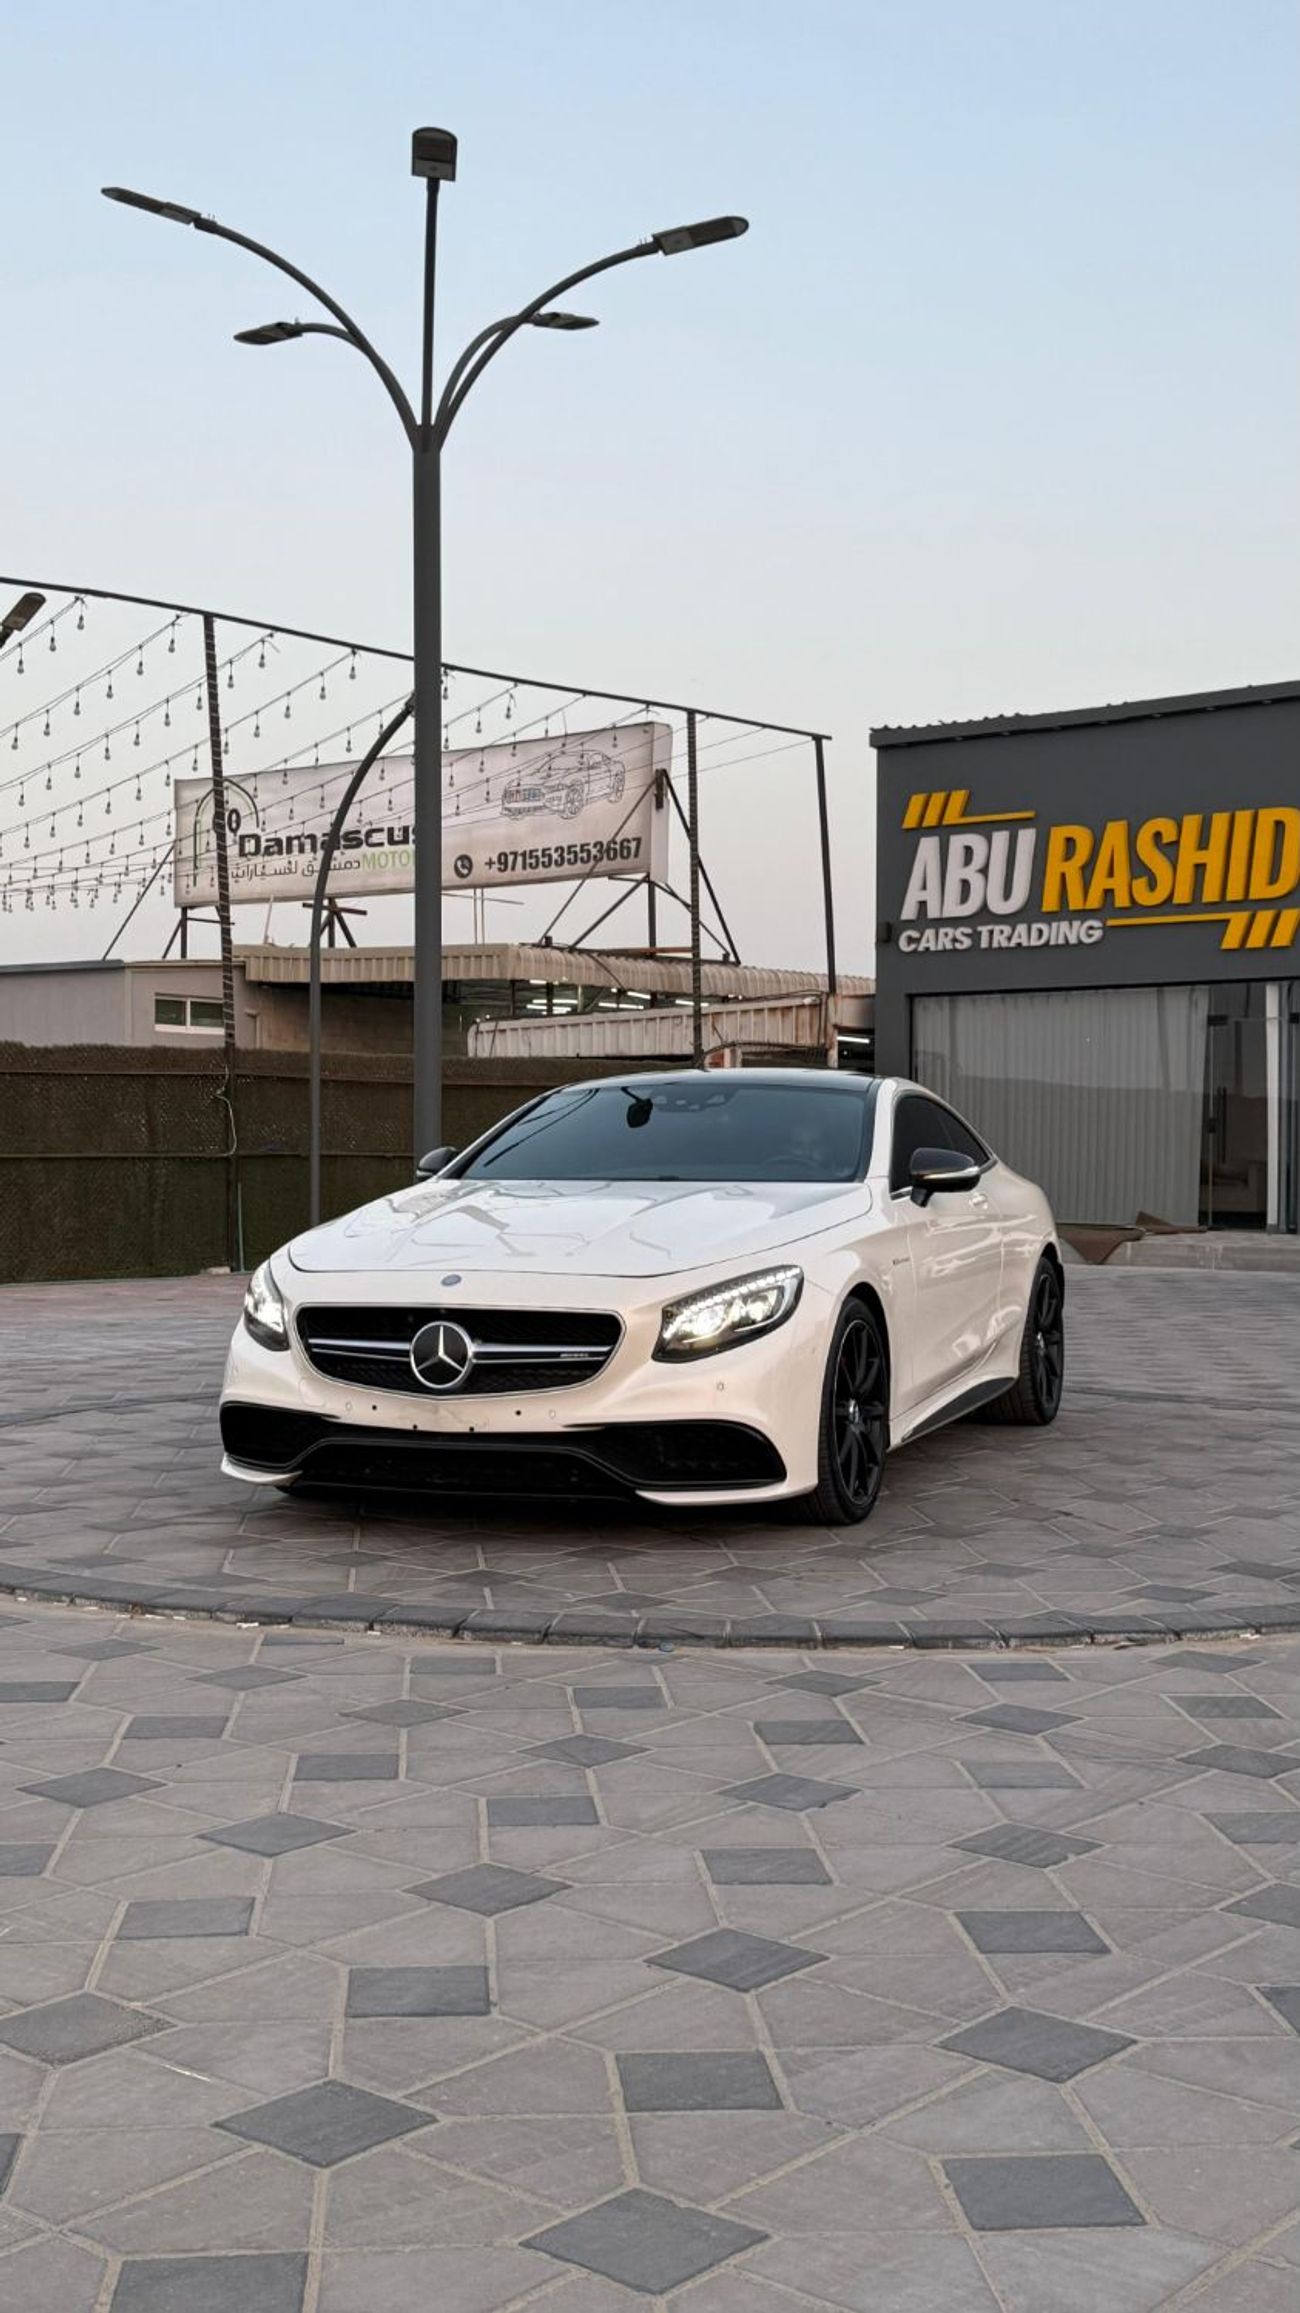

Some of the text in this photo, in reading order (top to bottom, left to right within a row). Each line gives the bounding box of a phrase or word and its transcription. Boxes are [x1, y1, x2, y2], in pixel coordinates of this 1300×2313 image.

[238, 825, 415, 858] Damascu
[484, 836, 642, 873] +971553553667
[362, 849, 414, 871] MOTO
[900, 806, 1300, 921] ABU RASHID
[899, 918, 1103, 953] CARS TRADING
